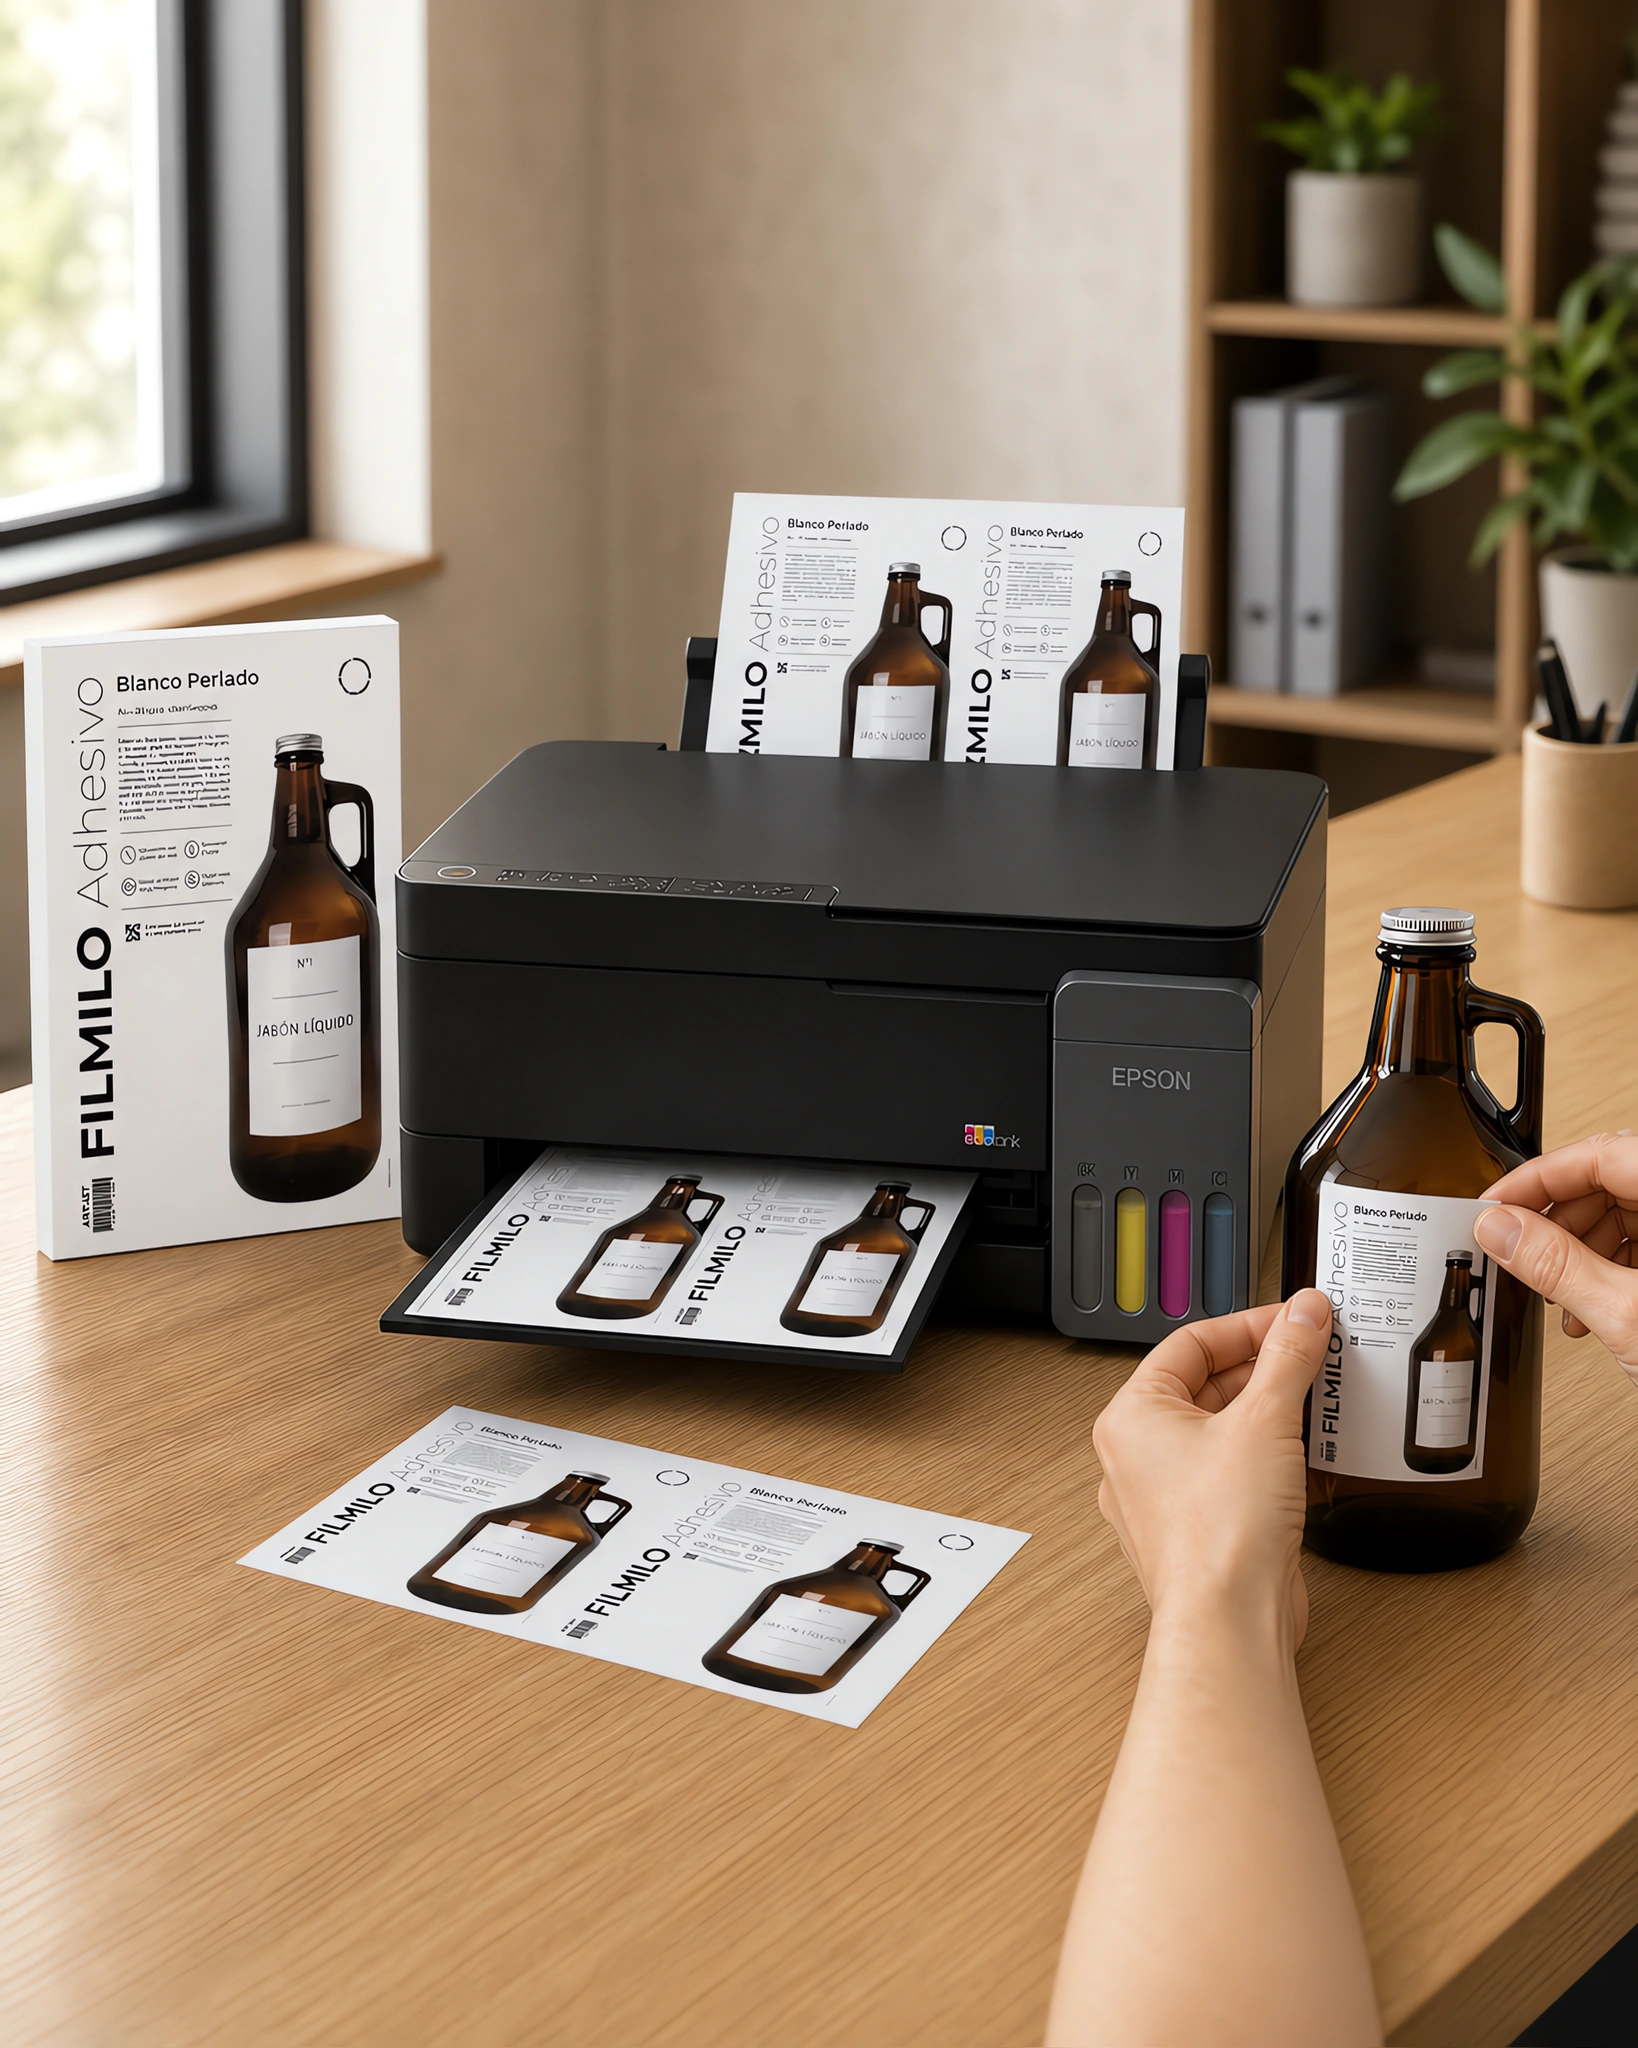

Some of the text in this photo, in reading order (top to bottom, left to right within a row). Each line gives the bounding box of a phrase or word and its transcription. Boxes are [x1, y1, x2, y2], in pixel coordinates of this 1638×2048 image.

[787, 518, 870, 531] Blanco Perlado
[748, 517, 780, 653] Adhesivo
[974, 525, 1004, 660] Adhesivo
[117, 669, 260, 692] Blanco Perlado
[71, 677, 109, 908] Adhesivo
[76, 927, 114, 1159] FILMILO
[257, 1013, 354, 1038] JABÓN LÍQUIDO
[1112, 1067, 1191, 1091] EPSON
[462, 1213, 530, 1282] FILMILO
[688, 1226, 746, 1301] FILMILO
[1321, 1332, 1343, 1434] FILMILO
[304, 1482, 395, 1544] FILMILO
[584, 1547, 671, 1617] FILMILO
